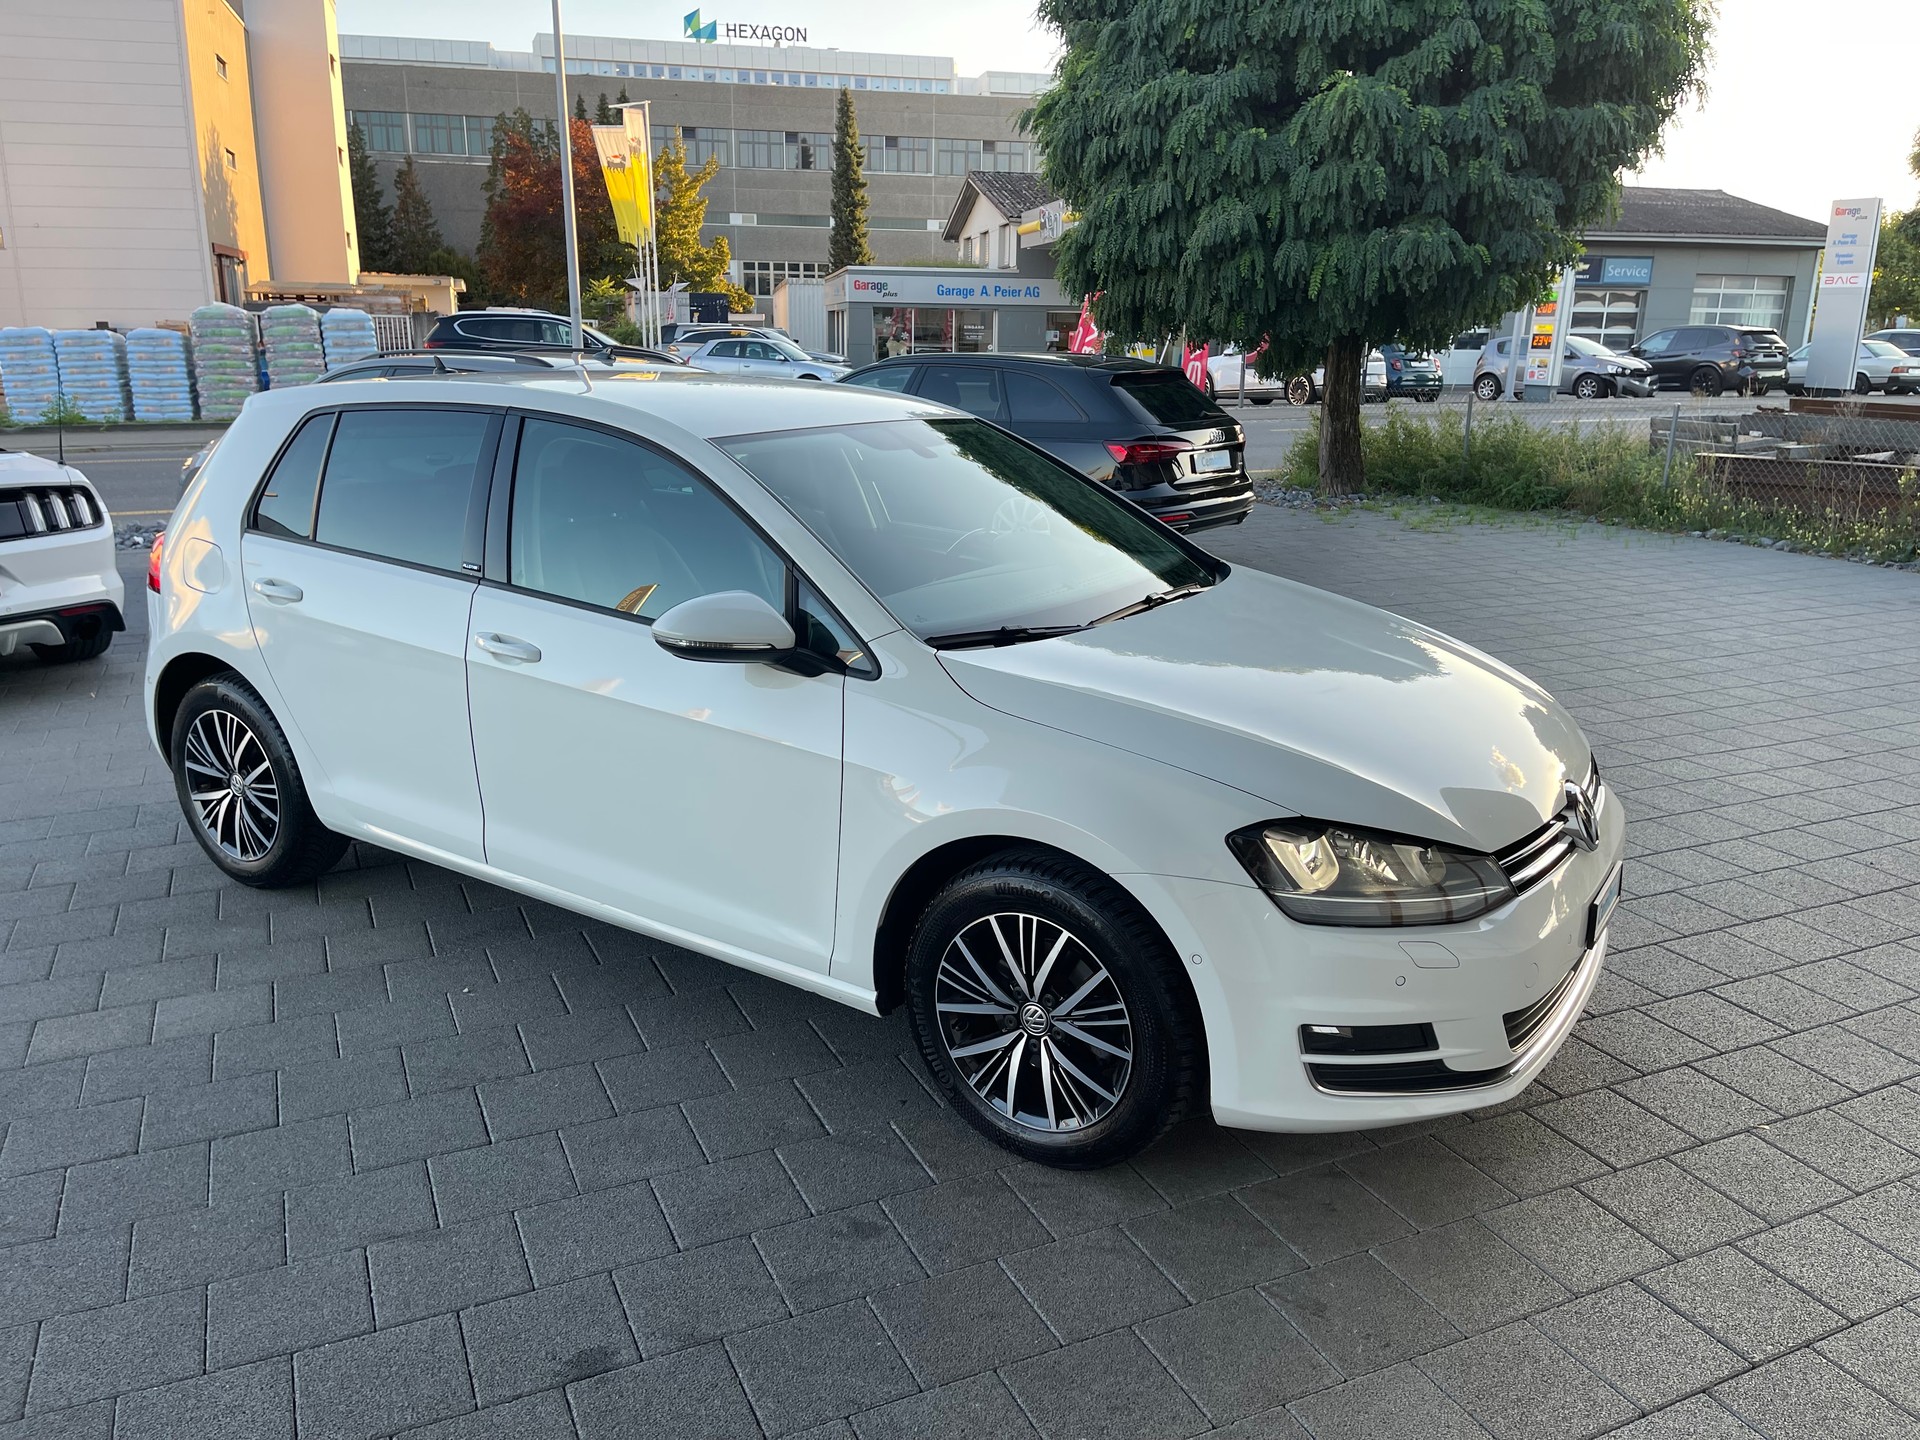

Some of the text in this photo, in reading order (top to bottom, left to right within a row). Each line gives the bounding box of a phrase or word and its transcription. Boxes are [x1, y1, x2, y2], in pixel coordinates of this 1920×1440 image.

[726, 23, 807, 42] HEXAGON
[1835, 207, 1861, 217] Garage
[1608, 265, 1648, 277] Service
[854, 279, 889, 293] Garage
[936, 284, 1041, 300] Garage A. Peier AG
[882, 291, 899, 299] plus
